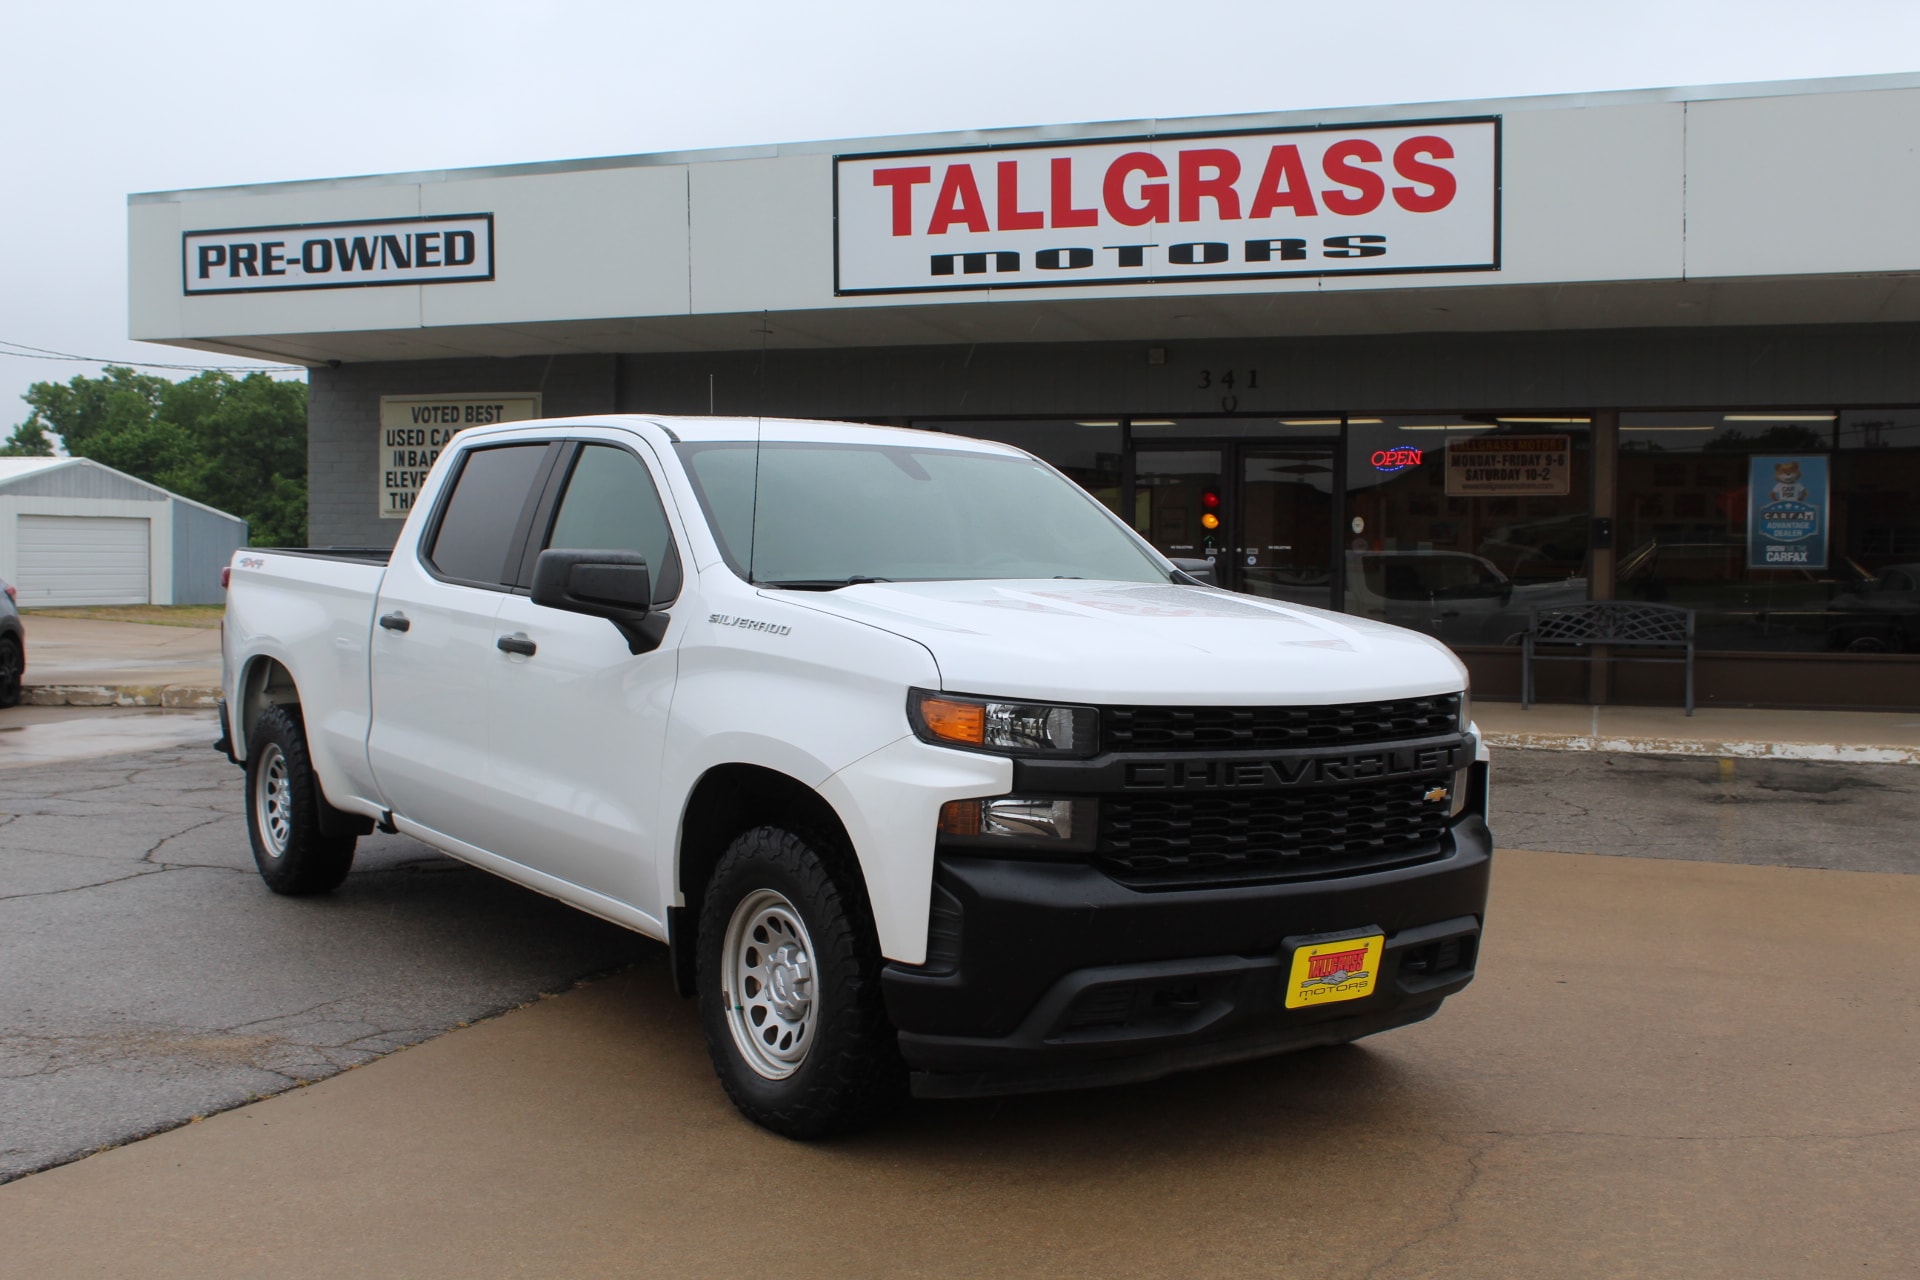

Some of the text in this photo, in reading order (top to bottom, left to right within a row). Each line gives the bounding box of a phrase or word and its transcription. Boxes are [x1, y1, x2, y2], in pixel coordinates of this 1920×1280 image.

[873, 136, 1457, 237] TALLGRASS
[198, 230, 476, 279] PRE-OWNED
[930, 234, 1387, 276] MOTORS
[1198, 368, 1258, 392] 341
[411, 405, 504, 424] VOTED BEST
[386, 429, 425, 447] USED
[1518, 439, 1564, 450] MOTORS
[1371, 450, 1423, 466] OPEN
[1465, 468, 1552, 481] SATURDAY 10-2
[1774, 529, 1803, 537] DEALER
[1766, 552, 1808, 562] CARFAX
[708, 613, 792, 636] SILVERADO
[1124, 747, 1462, 789] CHEVROLET
[1308, 948, 1368, 979] TALLGRASS
[1299, 980, 1368, 998] MOTORS
